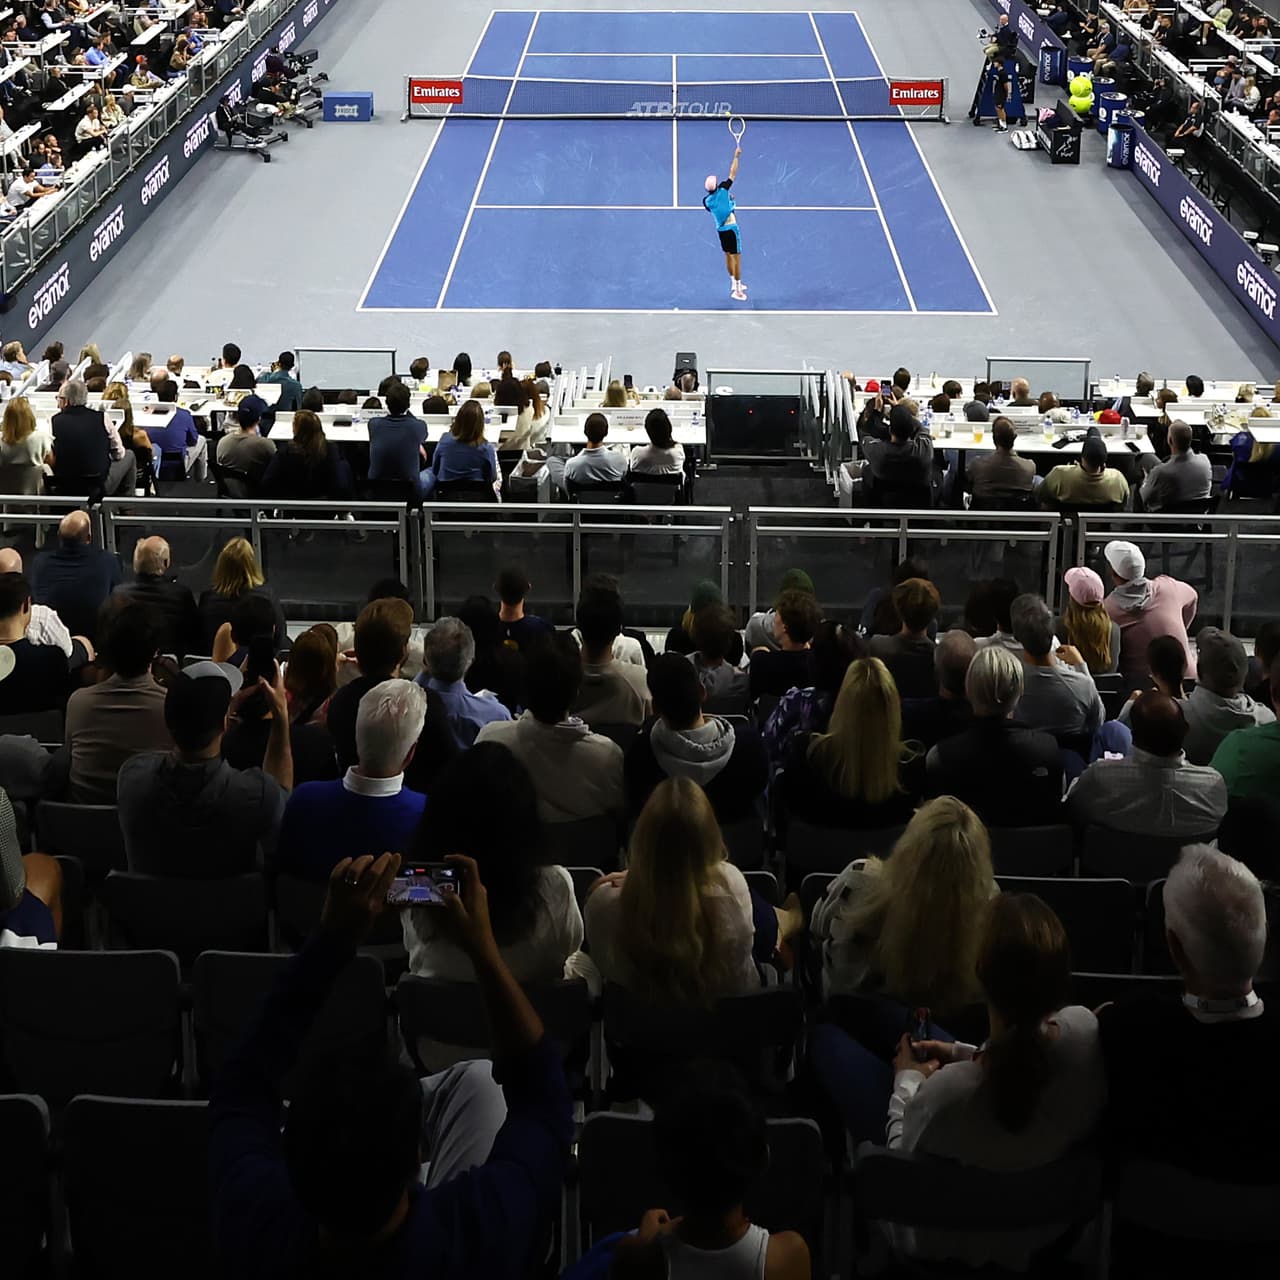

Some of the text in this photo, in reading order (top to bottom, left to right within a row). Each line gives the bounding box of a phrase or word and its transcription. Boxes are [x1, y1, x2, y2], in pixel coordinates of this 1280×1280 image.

[1044, 52, 1052, 81] evamor
[414, 86, 460, 97] Emirates
[892, 88, 939, 98] Emirates
[184, 119, 209, 158] evamor
[1122, 133, 1130, 165] evamor
[141, 160, 170, 205] evamor
[1134, 146, 1161, 187] evamor
[90, 210, 124, 261] evamor
[1180, 198, 1213, 246] evamor
[28, 269, 70, 329] evamor
[1237, 263, 1276, 320] evamor
